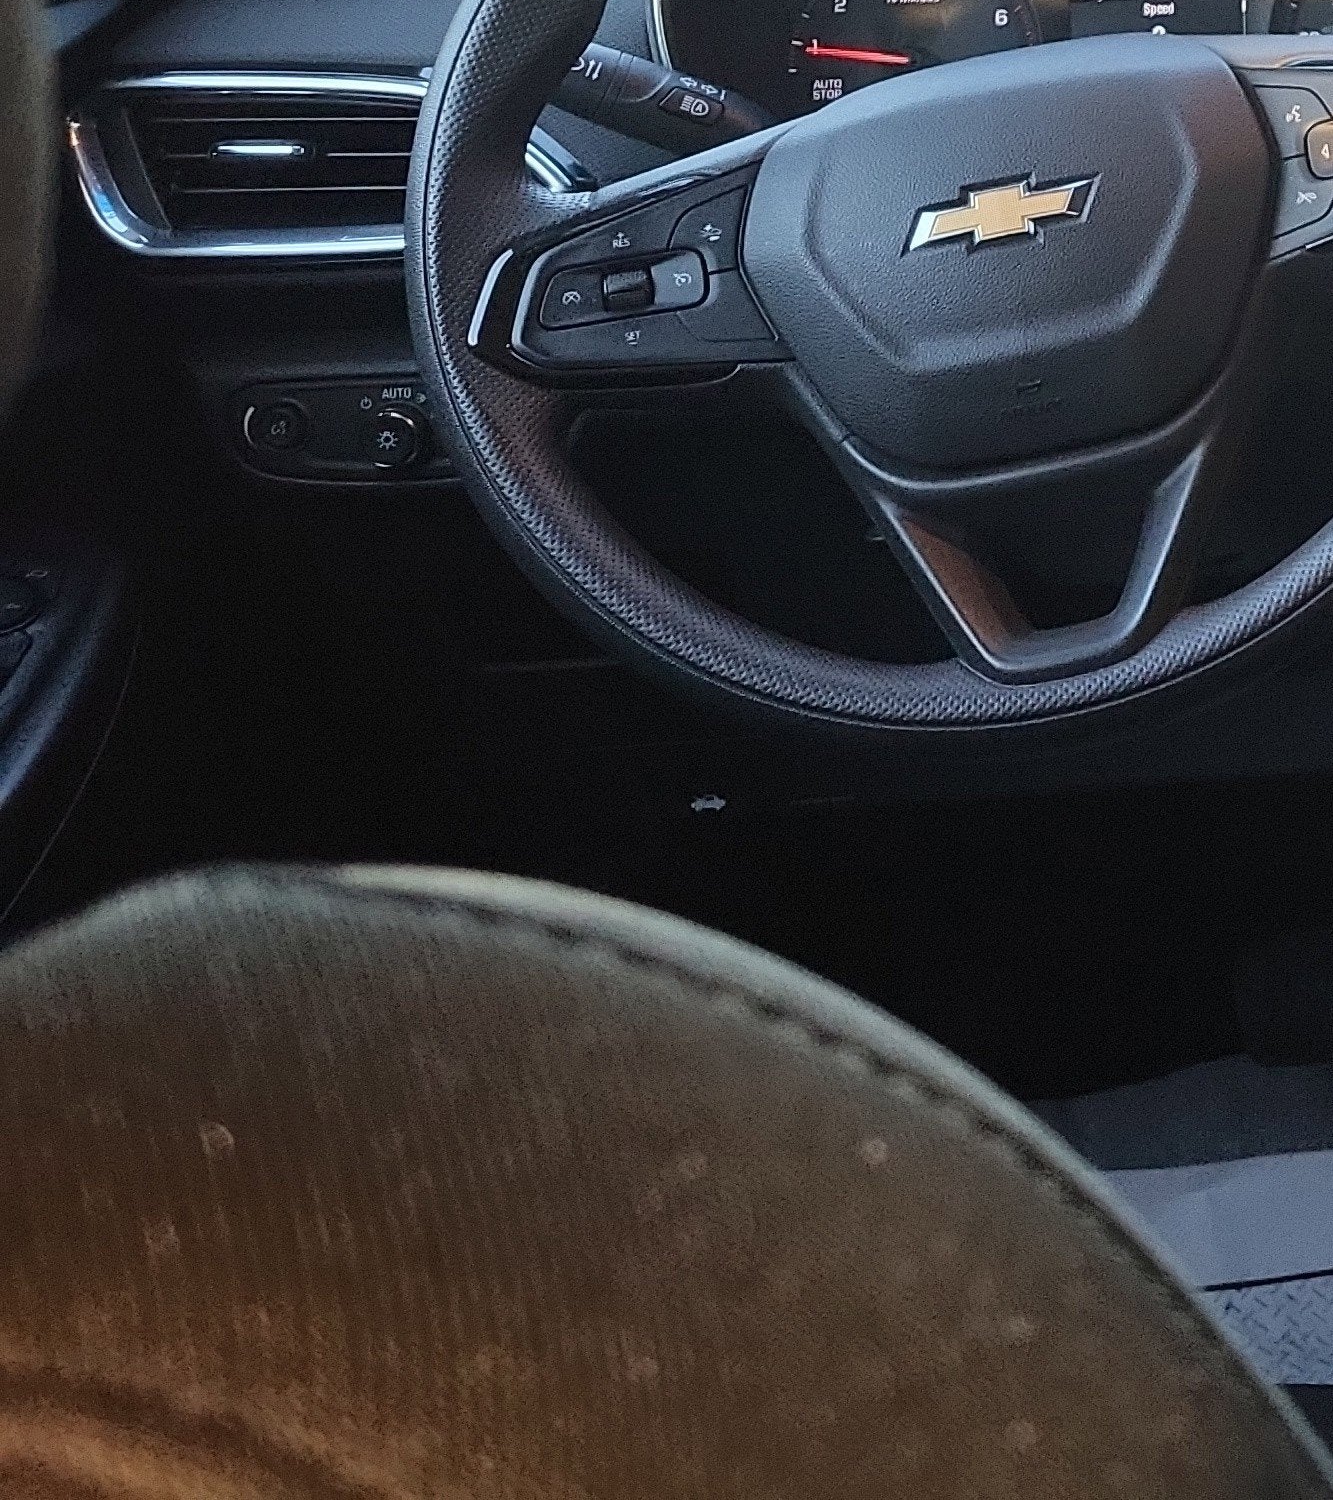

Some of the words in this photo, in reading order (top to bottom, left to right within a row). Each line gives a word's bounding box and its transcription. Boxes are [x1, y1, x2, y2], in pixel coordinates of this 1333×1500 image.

[1143, 2, 1175, 17] Speed
[995, 8, 1009, 27] 6
[813, 78, 843, 89] AUTO
[813, 89, 842, 100] STOP
[613, 238, 631, 249] RES
[625, 329, 640, 341] SET
[381, 387, 412, 399] AUTO
